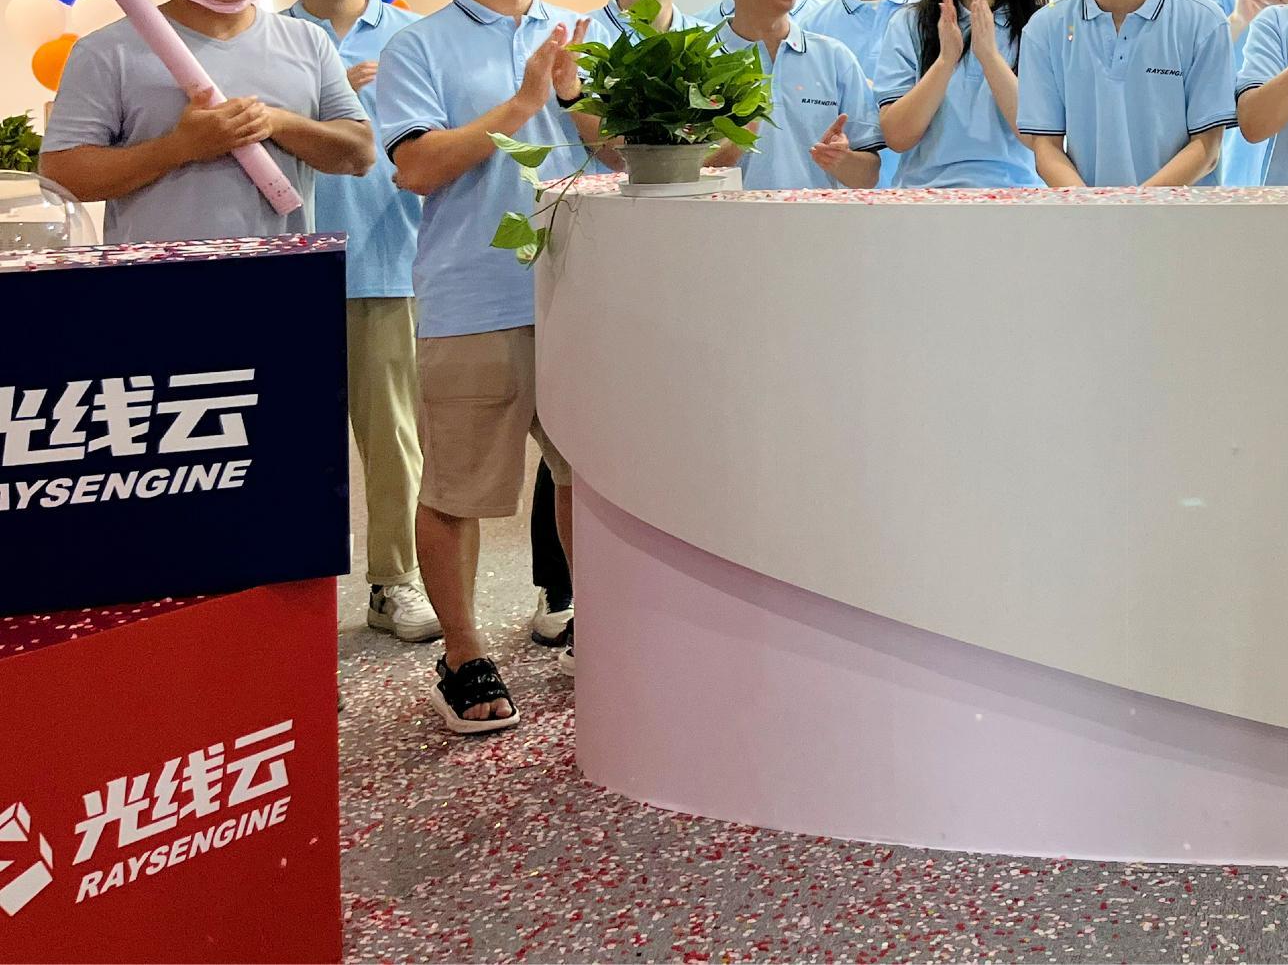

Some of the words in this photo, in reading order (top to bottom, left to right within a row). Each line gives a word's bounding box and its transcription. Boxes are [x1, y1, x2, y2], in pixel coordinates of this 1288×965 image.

[0, 368, 258, 467] 光线云
[72, 718, 295, 866] 光线云
[75, 795, 292, 904] RAYSENGINE
